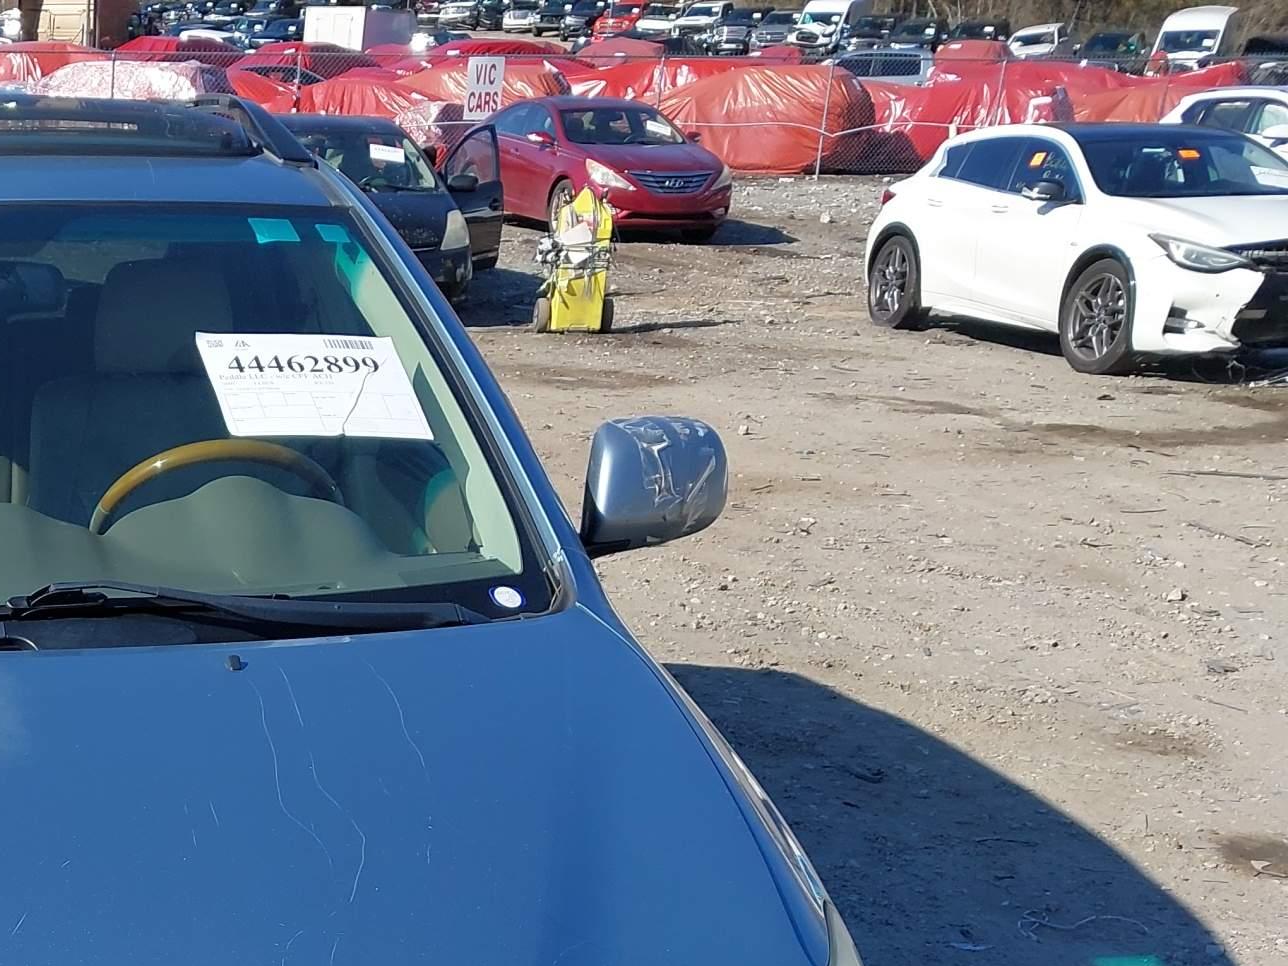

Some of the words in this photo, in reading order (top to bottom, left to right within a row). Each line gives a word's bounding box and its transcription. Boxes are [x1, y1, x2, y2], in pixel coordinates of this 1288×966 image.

[475, 63, 497, 85] VIC
[467, 91, 499, 113] CARS
[228, 355, 380, 373] 44462899
